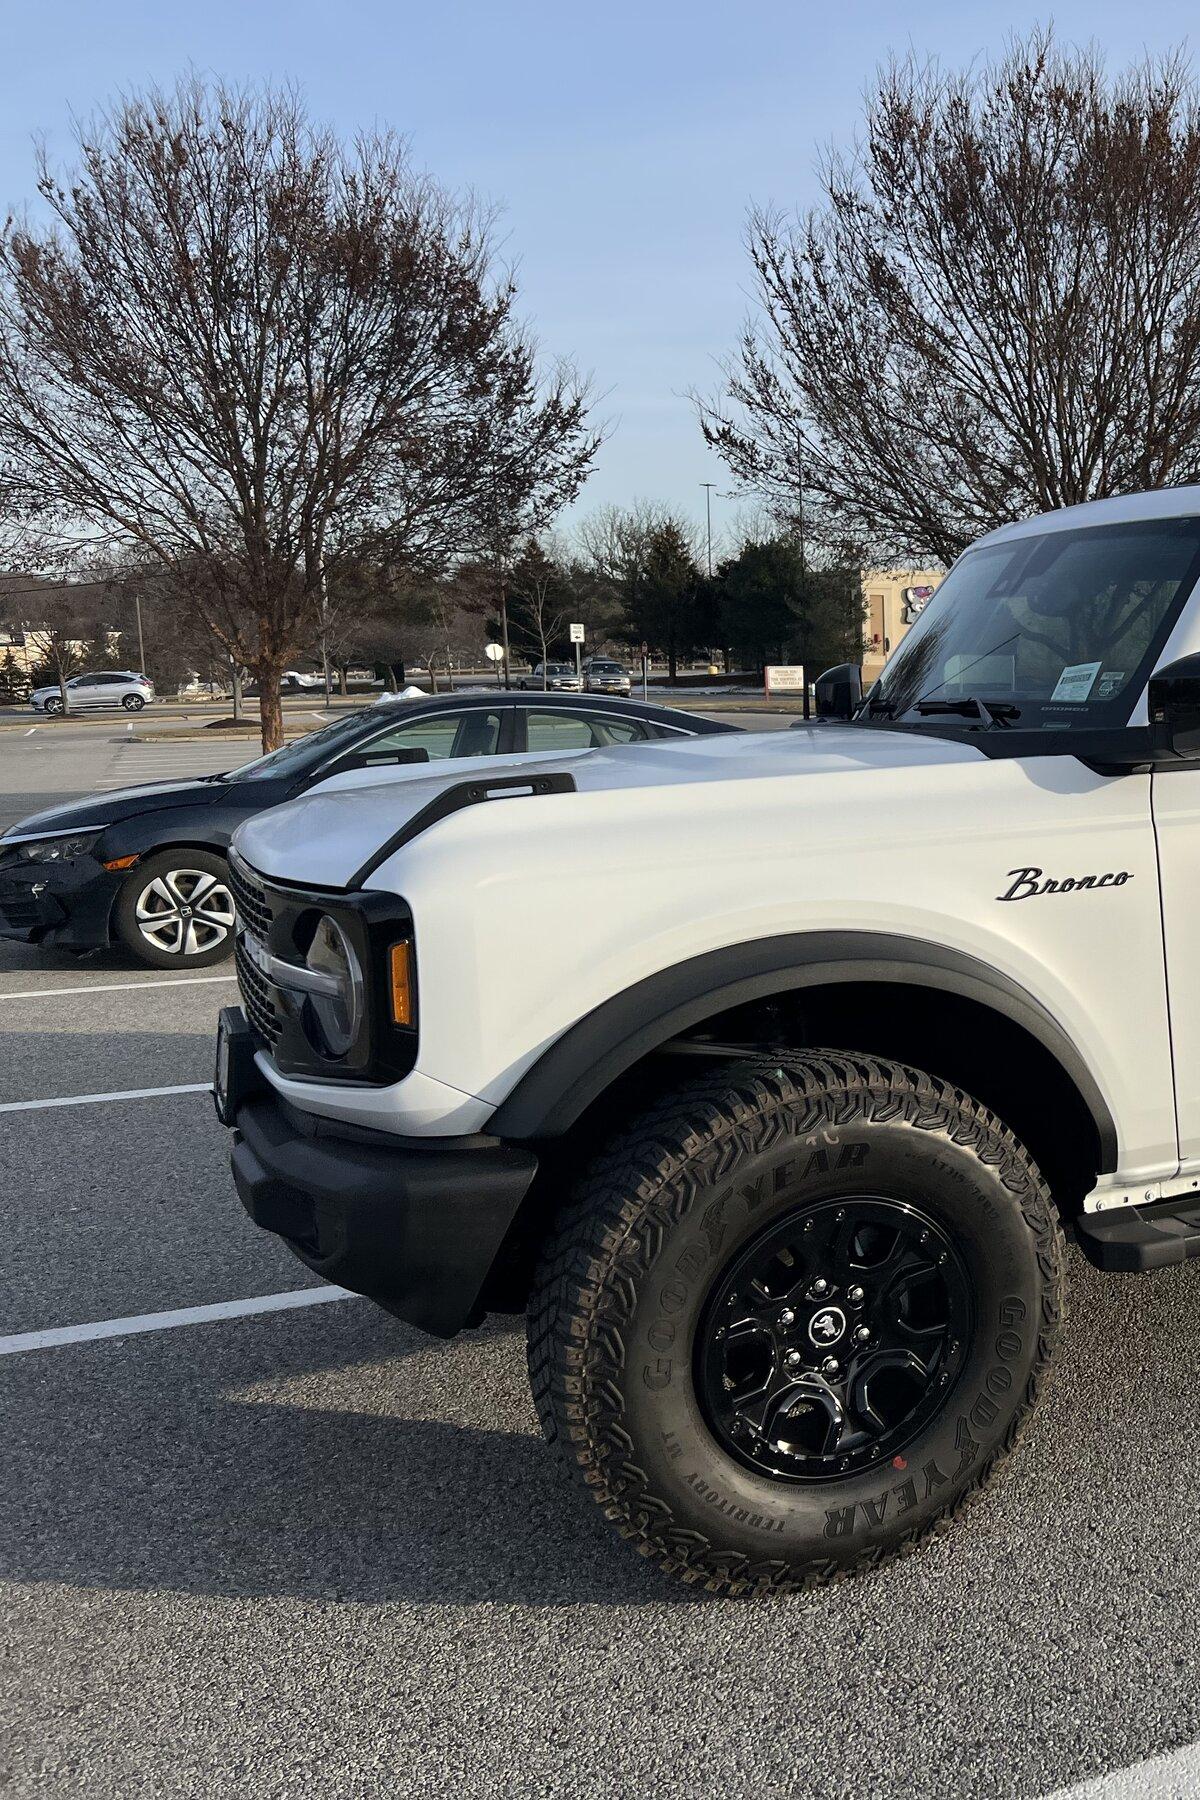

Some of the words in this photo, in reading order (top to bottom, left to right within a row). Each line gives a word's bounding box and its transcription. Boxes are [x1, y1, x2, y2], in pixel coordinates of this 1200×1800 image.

[995, 867, 1135, 901] Bronco
[643, 1143, 871, 1391] GOODYEAR
[823, 1295, 1027, 1540] GOODYEAR
[684, 1471, 787, 1533] TERRITORY
